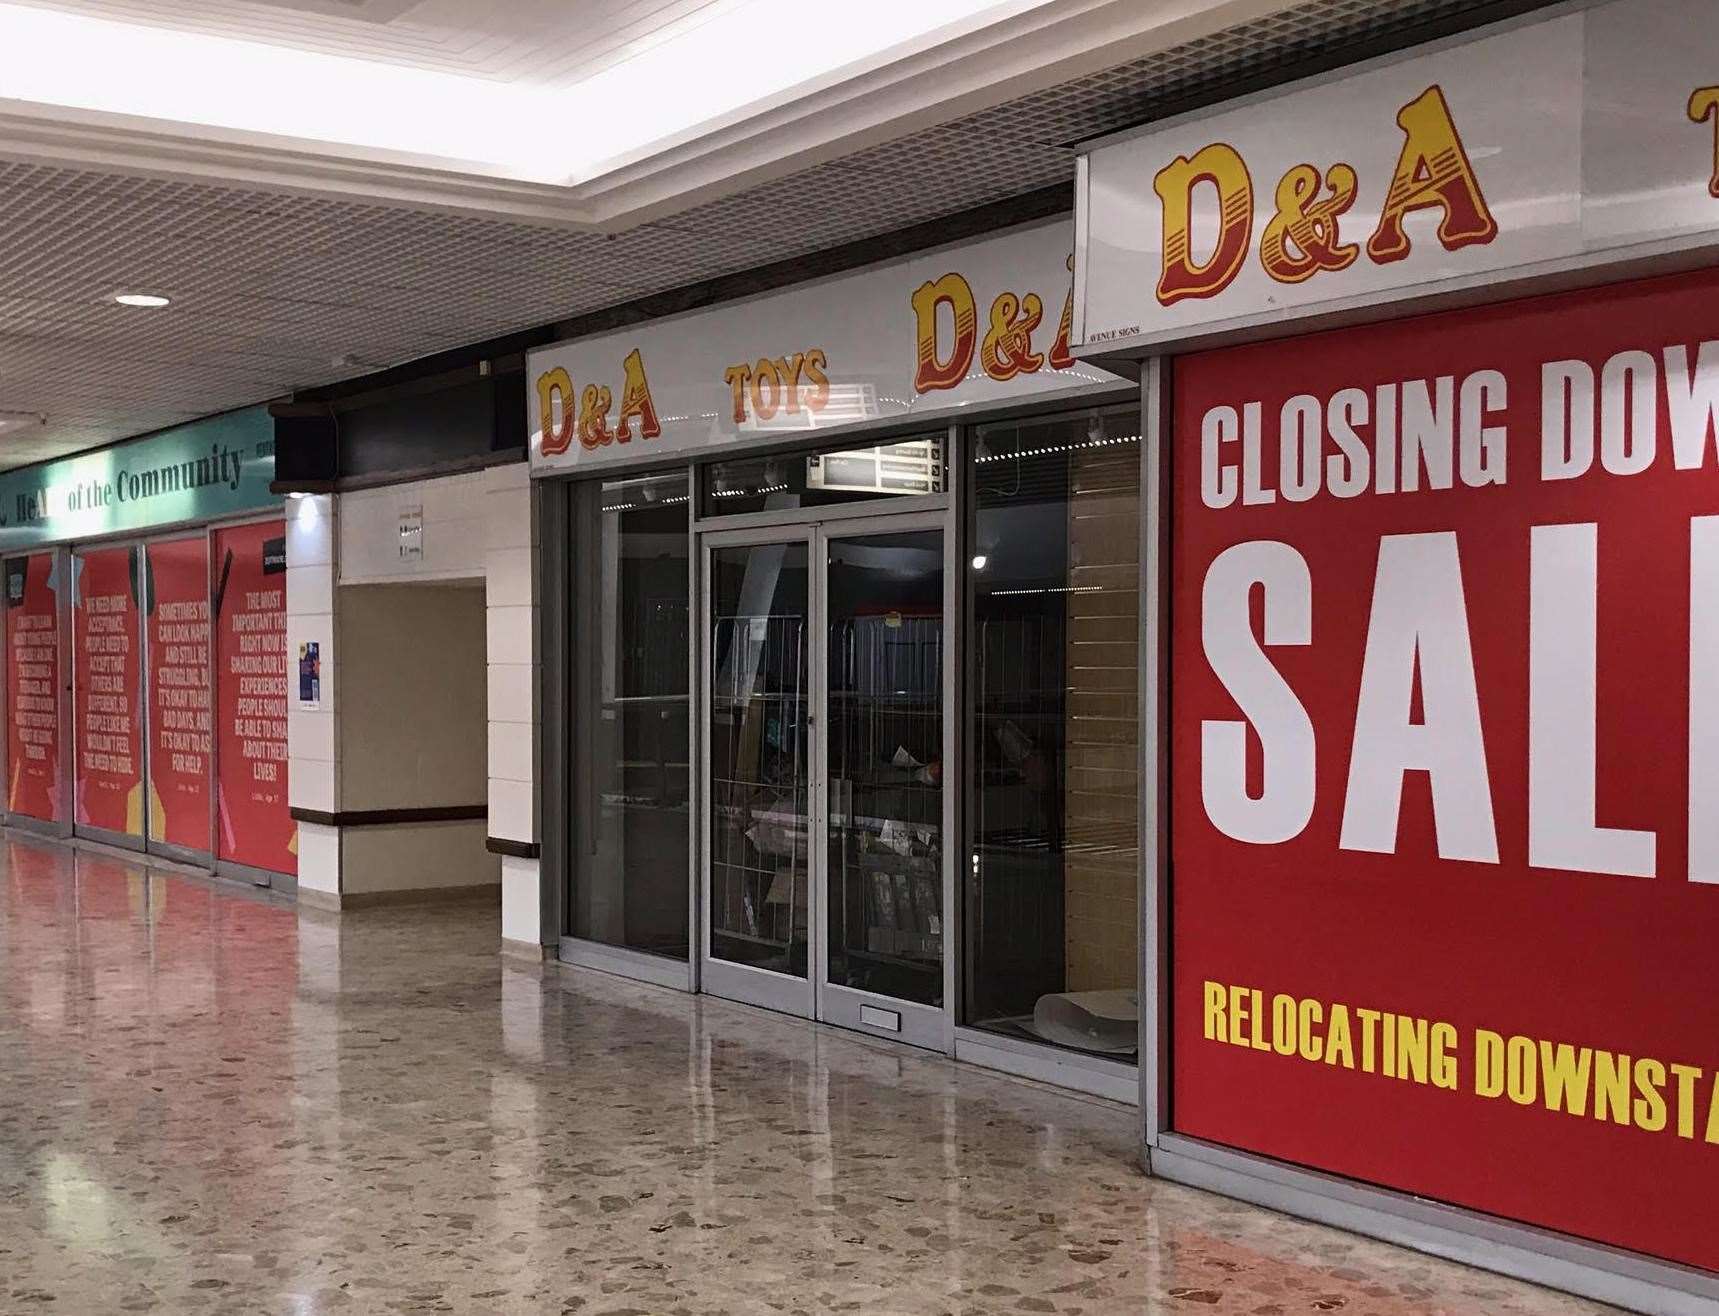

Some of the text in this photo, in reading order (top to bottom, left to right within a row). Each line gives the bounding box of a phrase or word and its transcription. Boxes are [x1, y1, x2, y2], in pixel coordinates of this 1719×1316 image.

[1153, 83, 1498, 307] D&A
[536, 347, 661, 457] D&A
[724, 348, 830, 424] TOYS
[1200, 369, 1507, 509] CLOSING
[68, 480, 85, 512] of
[86, 478, 112, 509] the
[116, 443, 243, 502] Community
[1203, 980, 1719, 1145] RELOCATING DOWNST
